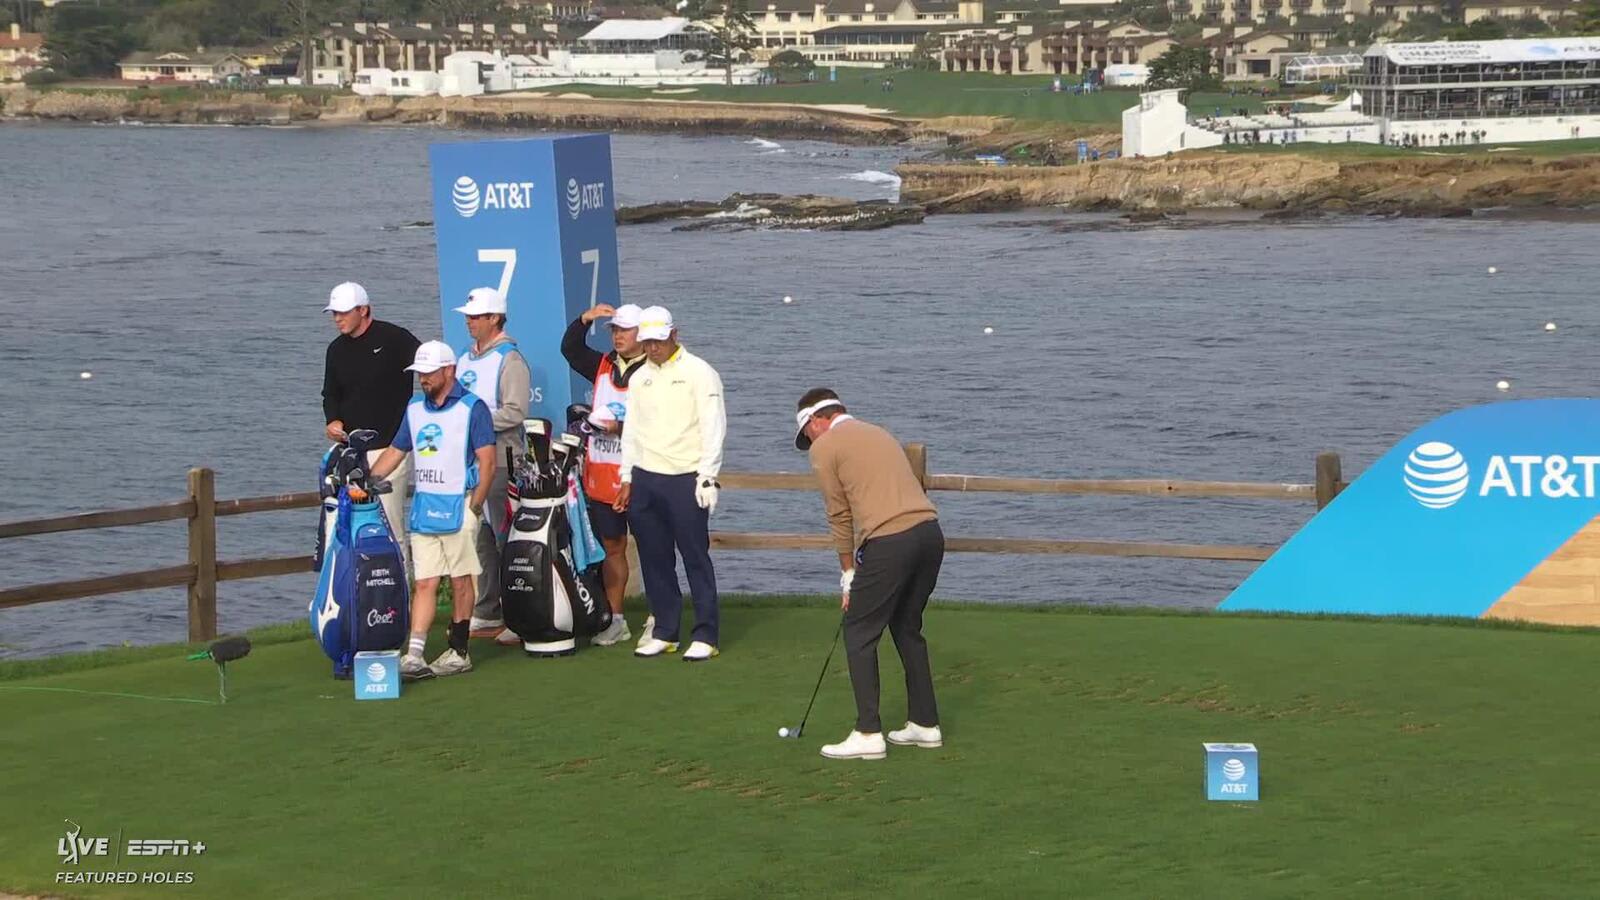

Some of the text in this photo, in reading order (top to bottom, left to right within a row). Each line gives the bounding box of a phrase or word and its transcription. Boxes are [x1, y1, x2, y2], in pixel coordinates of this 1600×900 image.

[484, 182, 534, 210] AT&T
[582, 182, 604, 211] AT&T
[477, 248, 517, 301] 7
[581, 248, 599, 335] 7
[1479, 455, 1600, 498] AT&T
[366, 578, 395, 588] MITCHELL
[371, 568, 390, 578] KEITH
[364, 684, 389, 693] AT&T
[1220, 783, 1249, 794] AT&T
